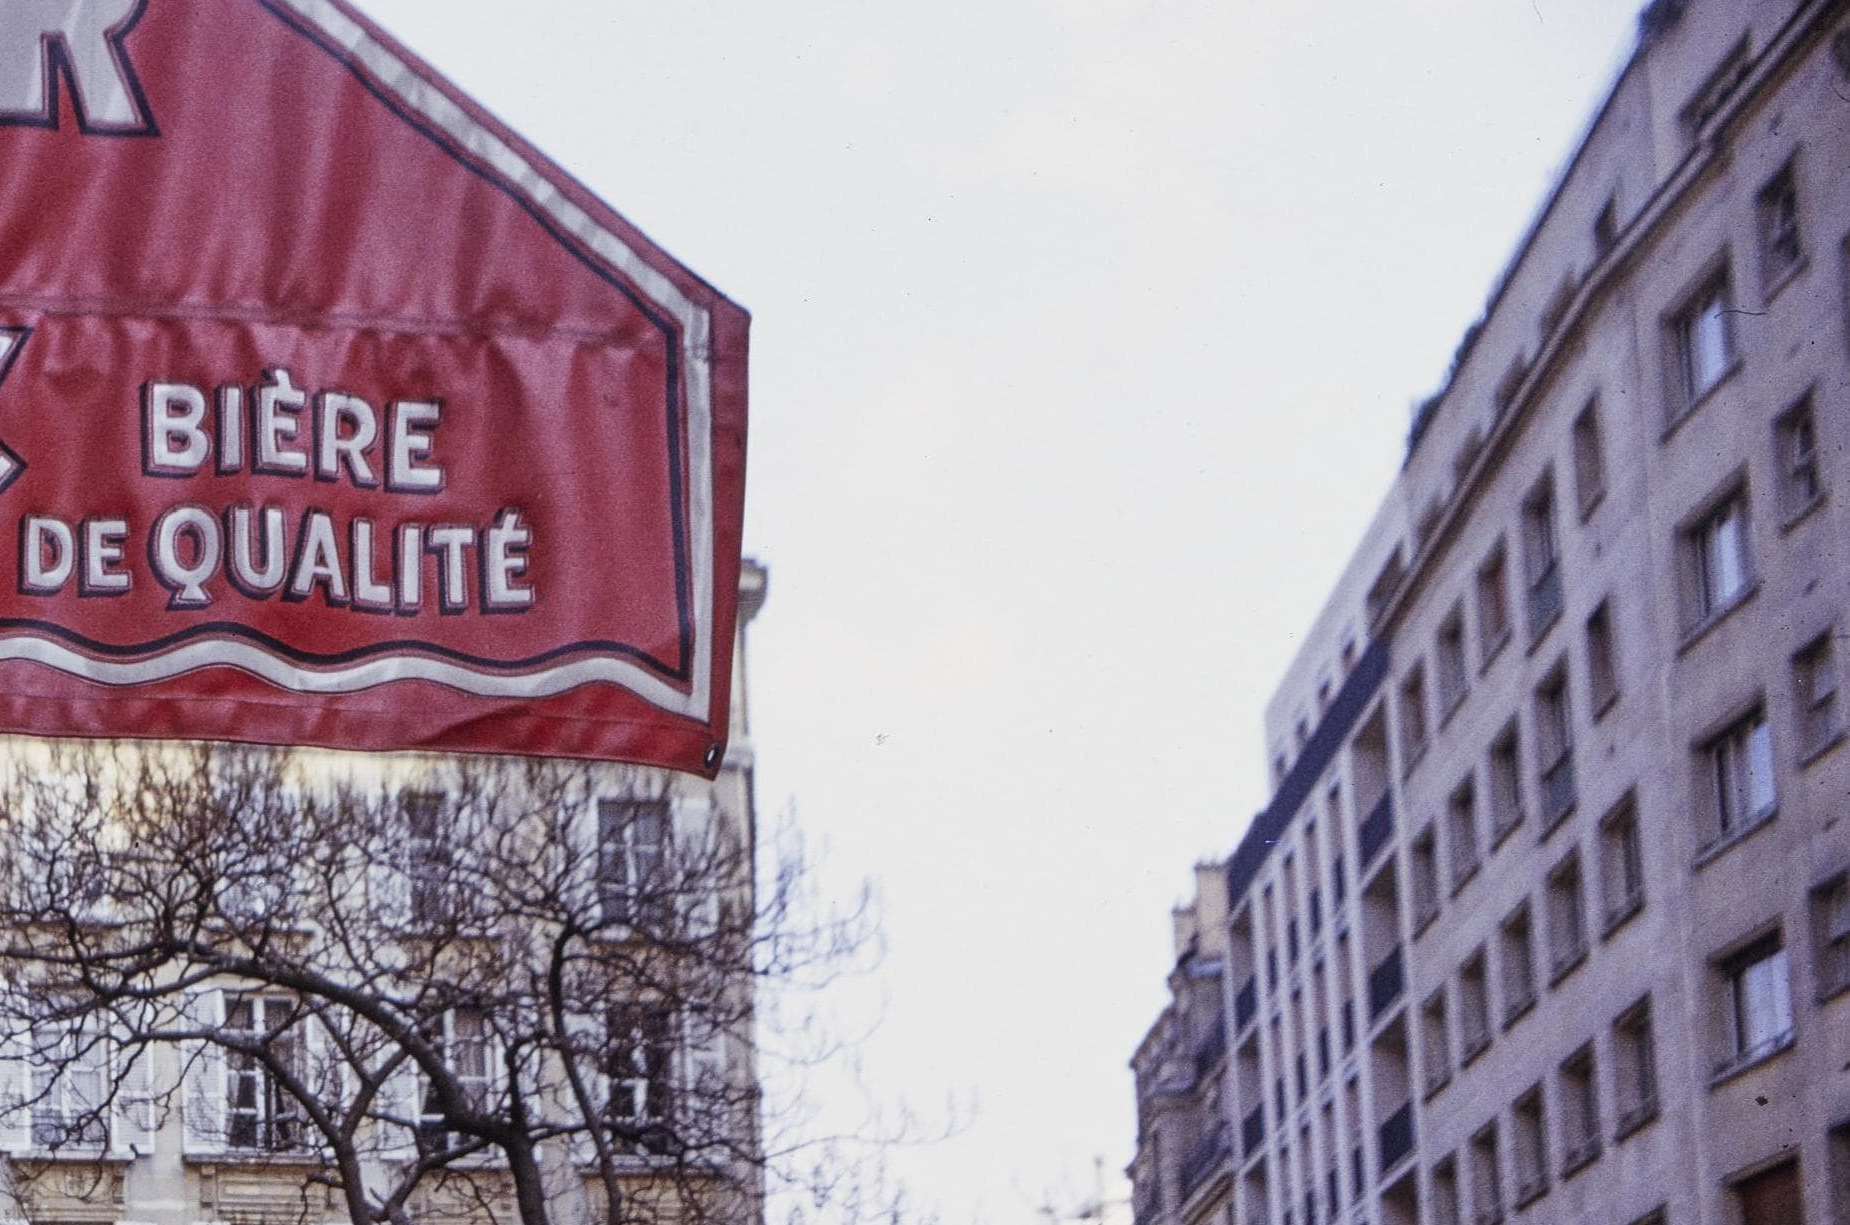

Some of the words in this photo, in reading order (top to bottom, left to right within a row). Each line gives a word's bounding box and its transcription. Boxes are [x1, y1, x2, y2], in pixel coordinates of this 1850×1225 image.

[140, 367, 445, 494] BIÈRE
[18, 512, 132, 597] DE
[150, 503, 536, 617] QUALITÉ
